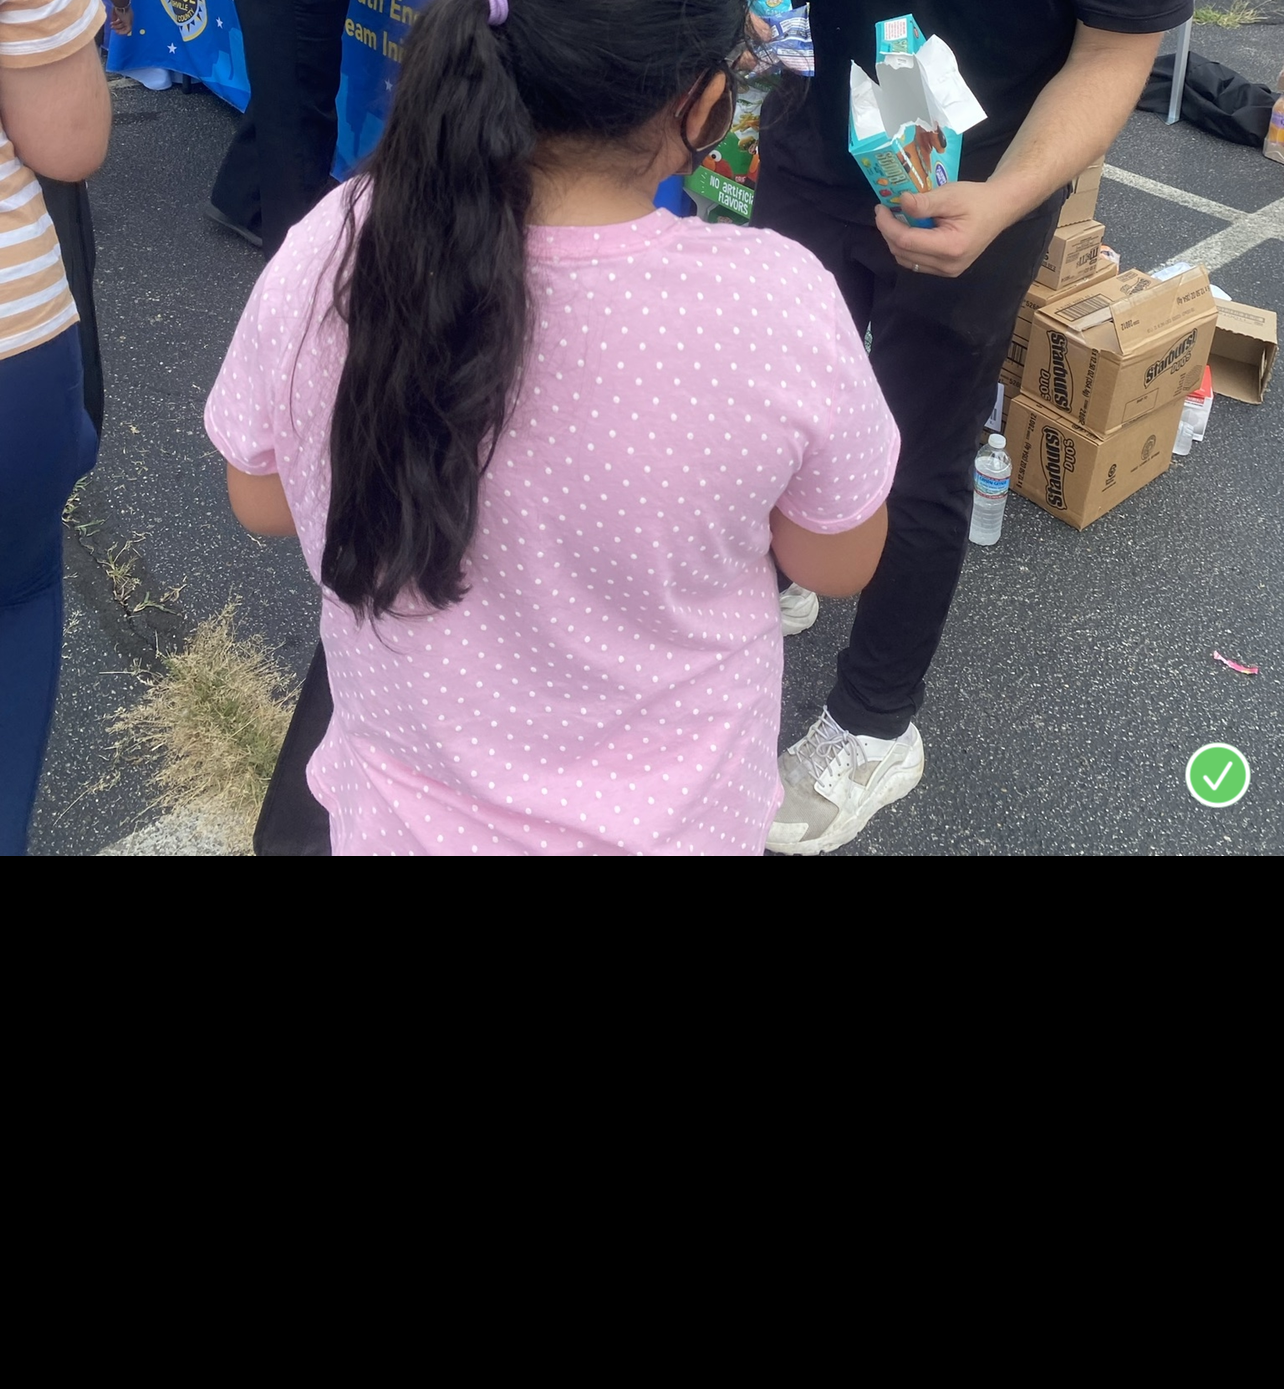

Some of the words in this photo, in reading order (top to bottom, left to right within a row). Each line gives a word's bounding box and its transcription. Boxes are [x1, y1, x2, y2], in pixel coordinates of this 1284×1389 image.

[345, 18, 377, 50] eam
[710, 175, 719, 189] NO
[1050, 332, 1070, 412] Starburst
[1147, 329, 1197, 385] Starburst
[1039, 368, 1051, 401] DUOS
[1044, 426, 1062, 508] Starburst
[1064, 439, 1076, 472] DUOS
